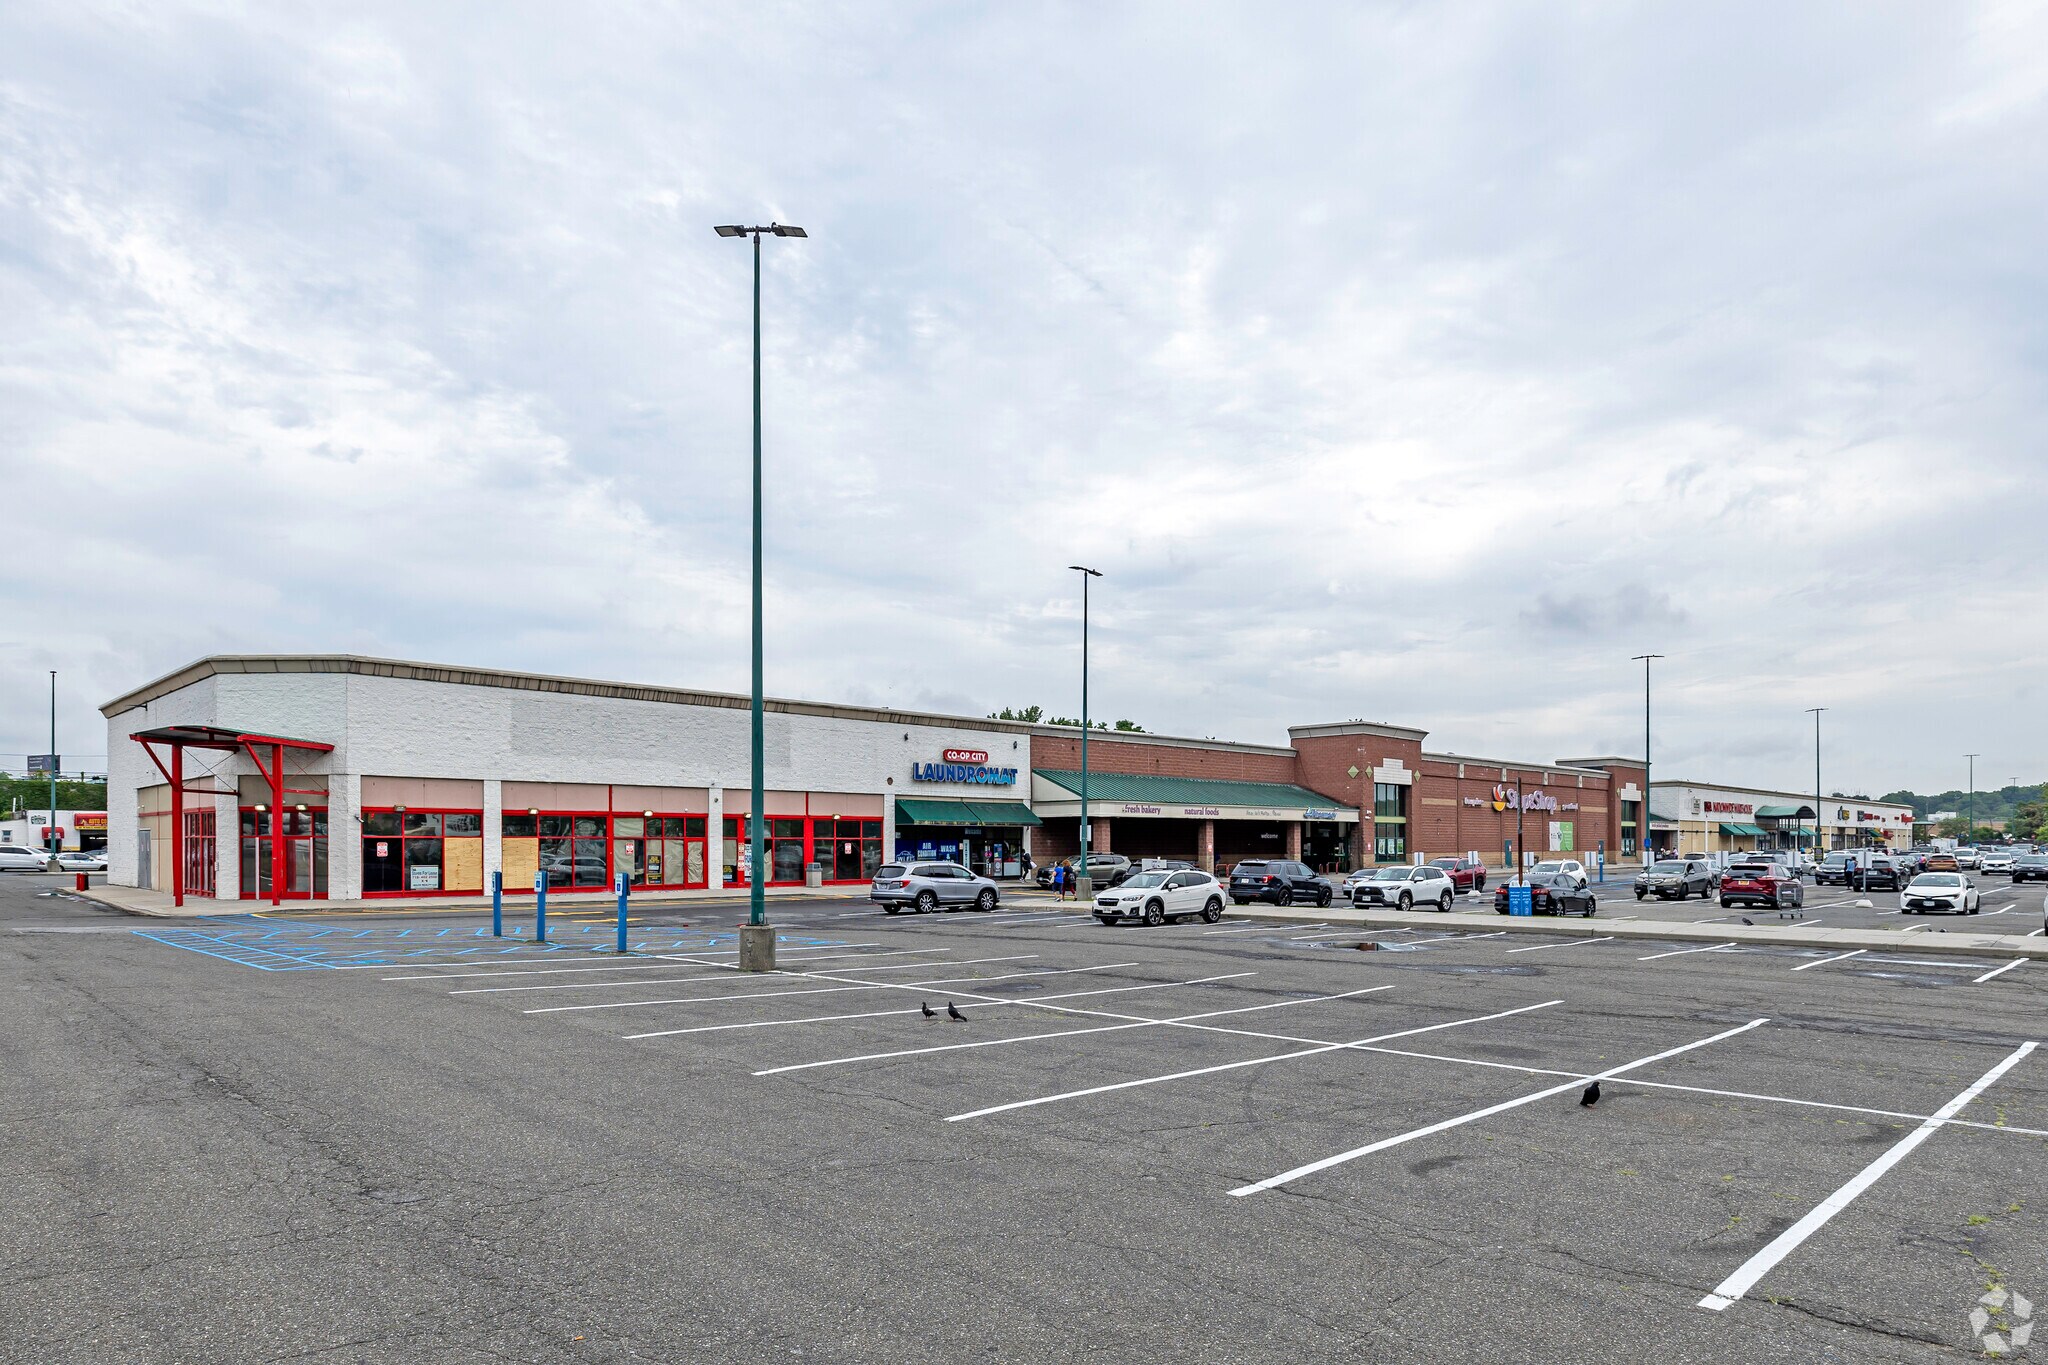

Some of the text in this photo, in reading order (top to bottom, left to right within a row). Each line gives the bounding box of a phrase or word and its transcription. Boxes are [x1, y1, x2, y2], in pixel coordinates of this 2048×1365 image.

[947, 750, 986, 761] CO-OP CITY
[913, 762, 1018, 785] LAUNDROMAT
[1124, 804, 1161, 815] fresh bakery
[1184, 807, 1220, 816] natural foods
